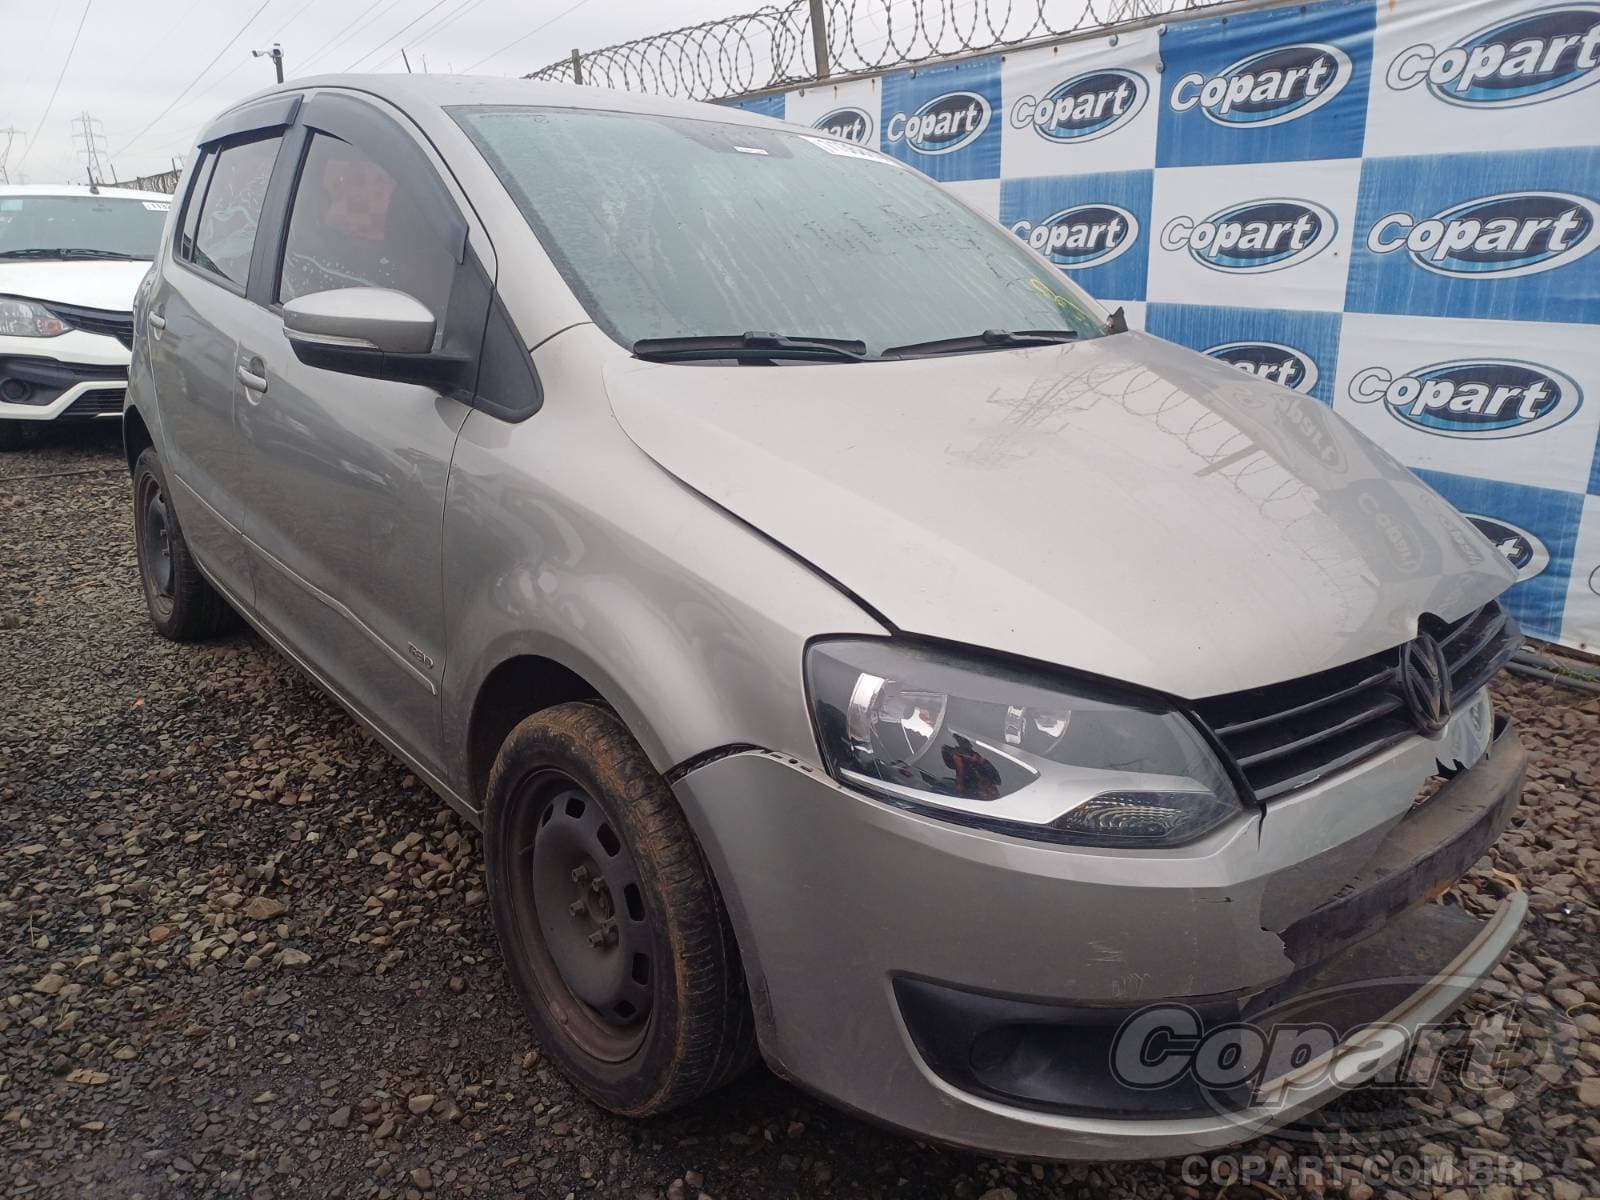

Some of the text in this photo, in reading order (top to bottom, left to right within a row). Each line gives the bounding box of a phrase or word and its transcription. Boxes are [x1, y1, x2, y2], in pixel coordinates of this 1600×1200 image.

[1386, 23, 1600, 92] Copart
[1010, 82, 1131, 137] Copart
[1170, 56, 1329, 115] Copart
[887, 101, 978, 145] Copart
[1161, 211, 1316, 257] Copart
[1367, 209, 1582, 261] Copart
[1348, 367, 1549, 418] Copart
